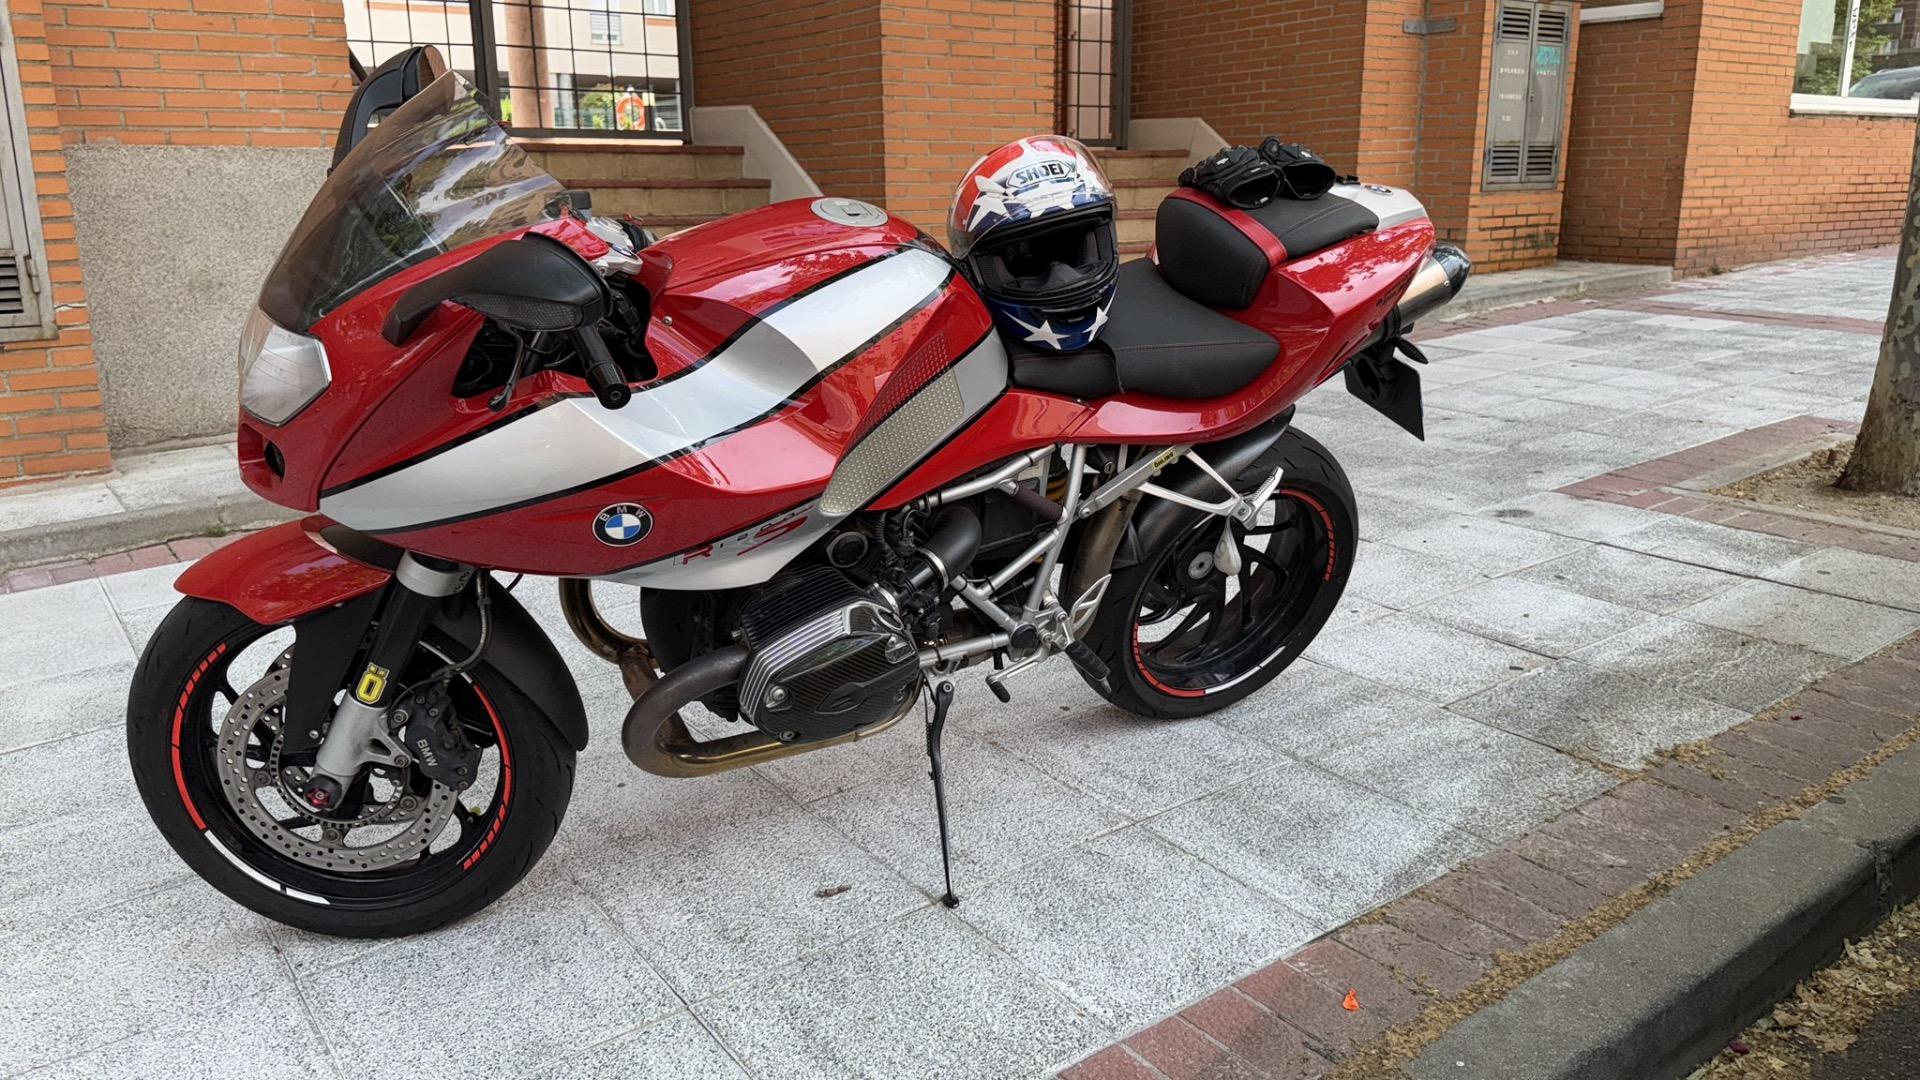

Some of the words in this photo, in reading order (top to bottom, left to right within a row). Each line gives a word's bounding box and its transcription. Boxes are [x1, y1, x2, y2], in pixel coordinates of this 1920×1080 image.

[1016, 163, 1064, 184] SHOEI
[600, 505, 646, 522] BMW
[417, 739, 438, 767] BMW
